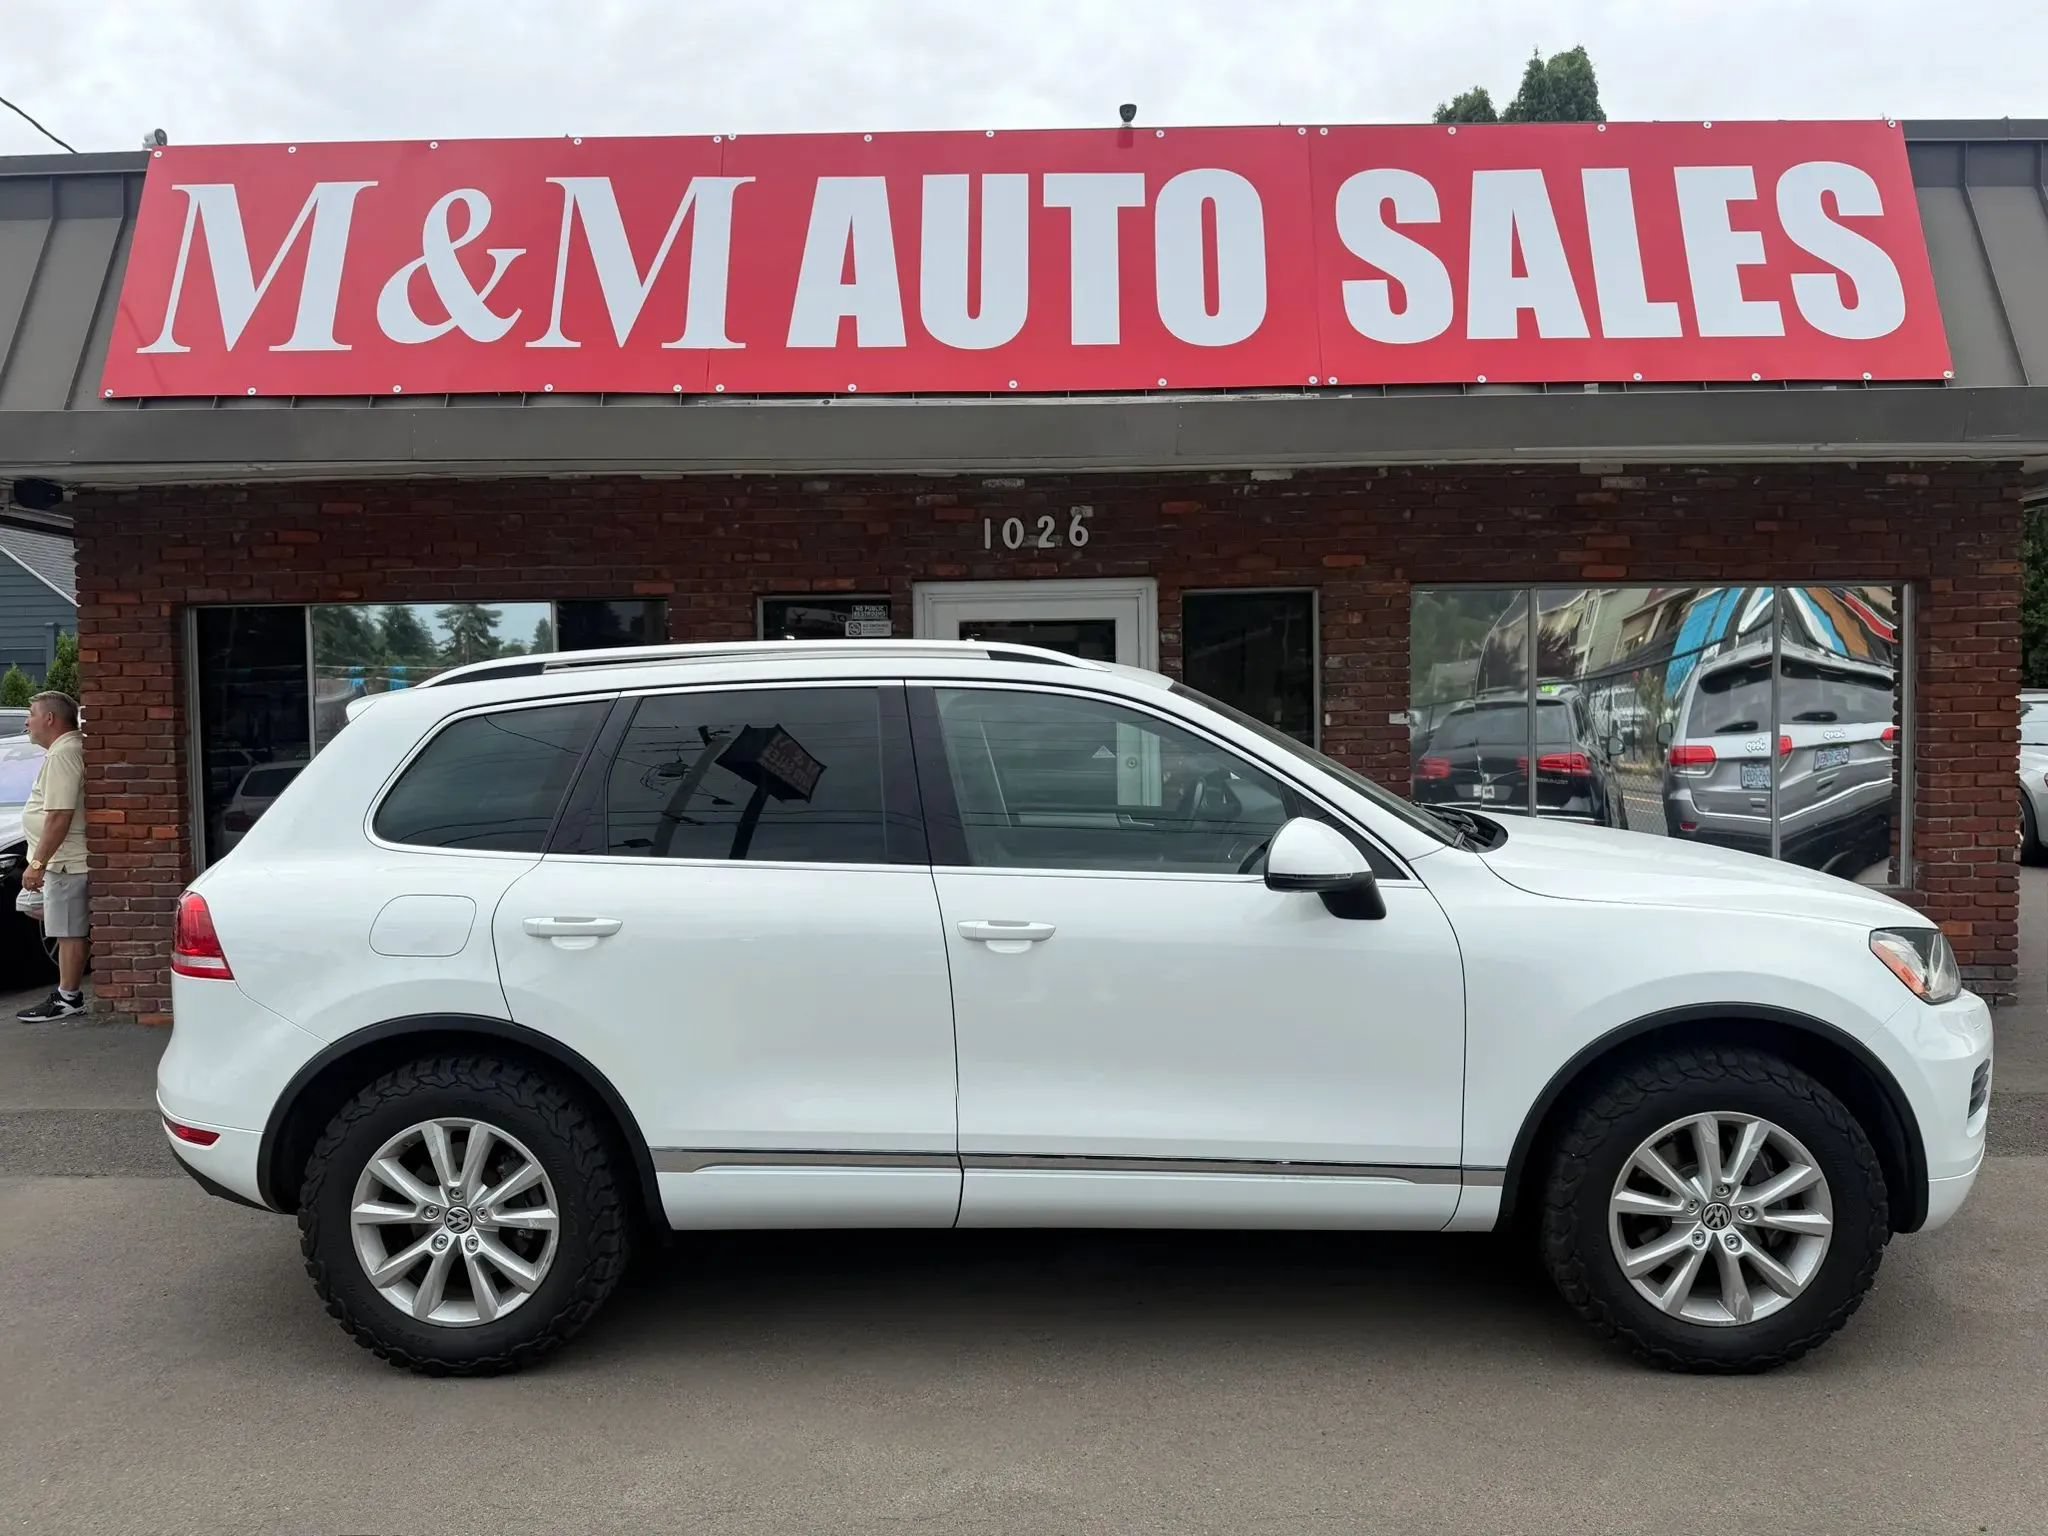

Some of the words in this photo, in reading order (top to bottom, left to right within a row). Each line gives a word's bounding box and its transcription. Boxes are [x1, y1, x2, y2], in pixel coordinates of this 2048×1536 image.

[136, 176, 756, 355] M&M
[786, 169, 1267, 349] AUTO
[1336, 161, 1905, 346] SALES
[984, 514, 1089, 550] 1026
